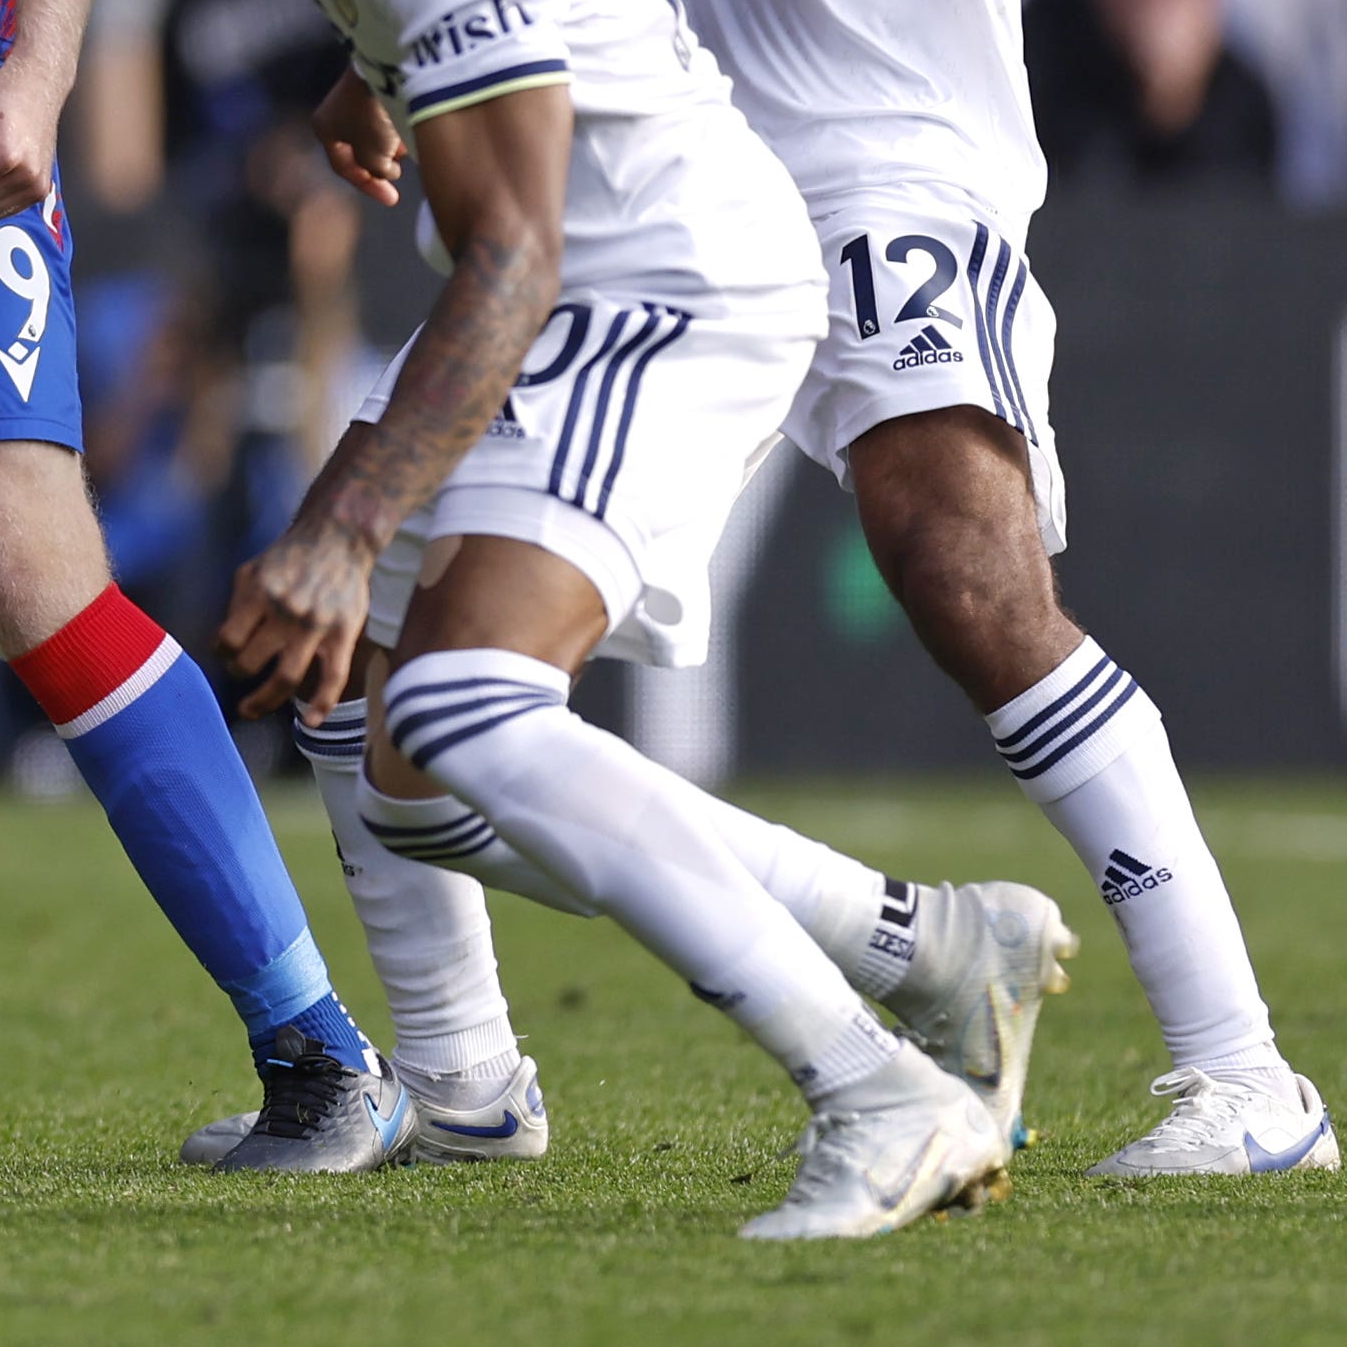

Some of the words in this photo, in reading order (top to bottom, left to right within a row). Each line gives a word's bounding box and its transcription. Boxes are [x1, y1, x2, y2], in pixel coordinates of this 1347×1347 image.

[840, 233, 963, 341] 12
[893, 349, 964, 371] adidas
[1103, 867, 1173, 905] adidas
